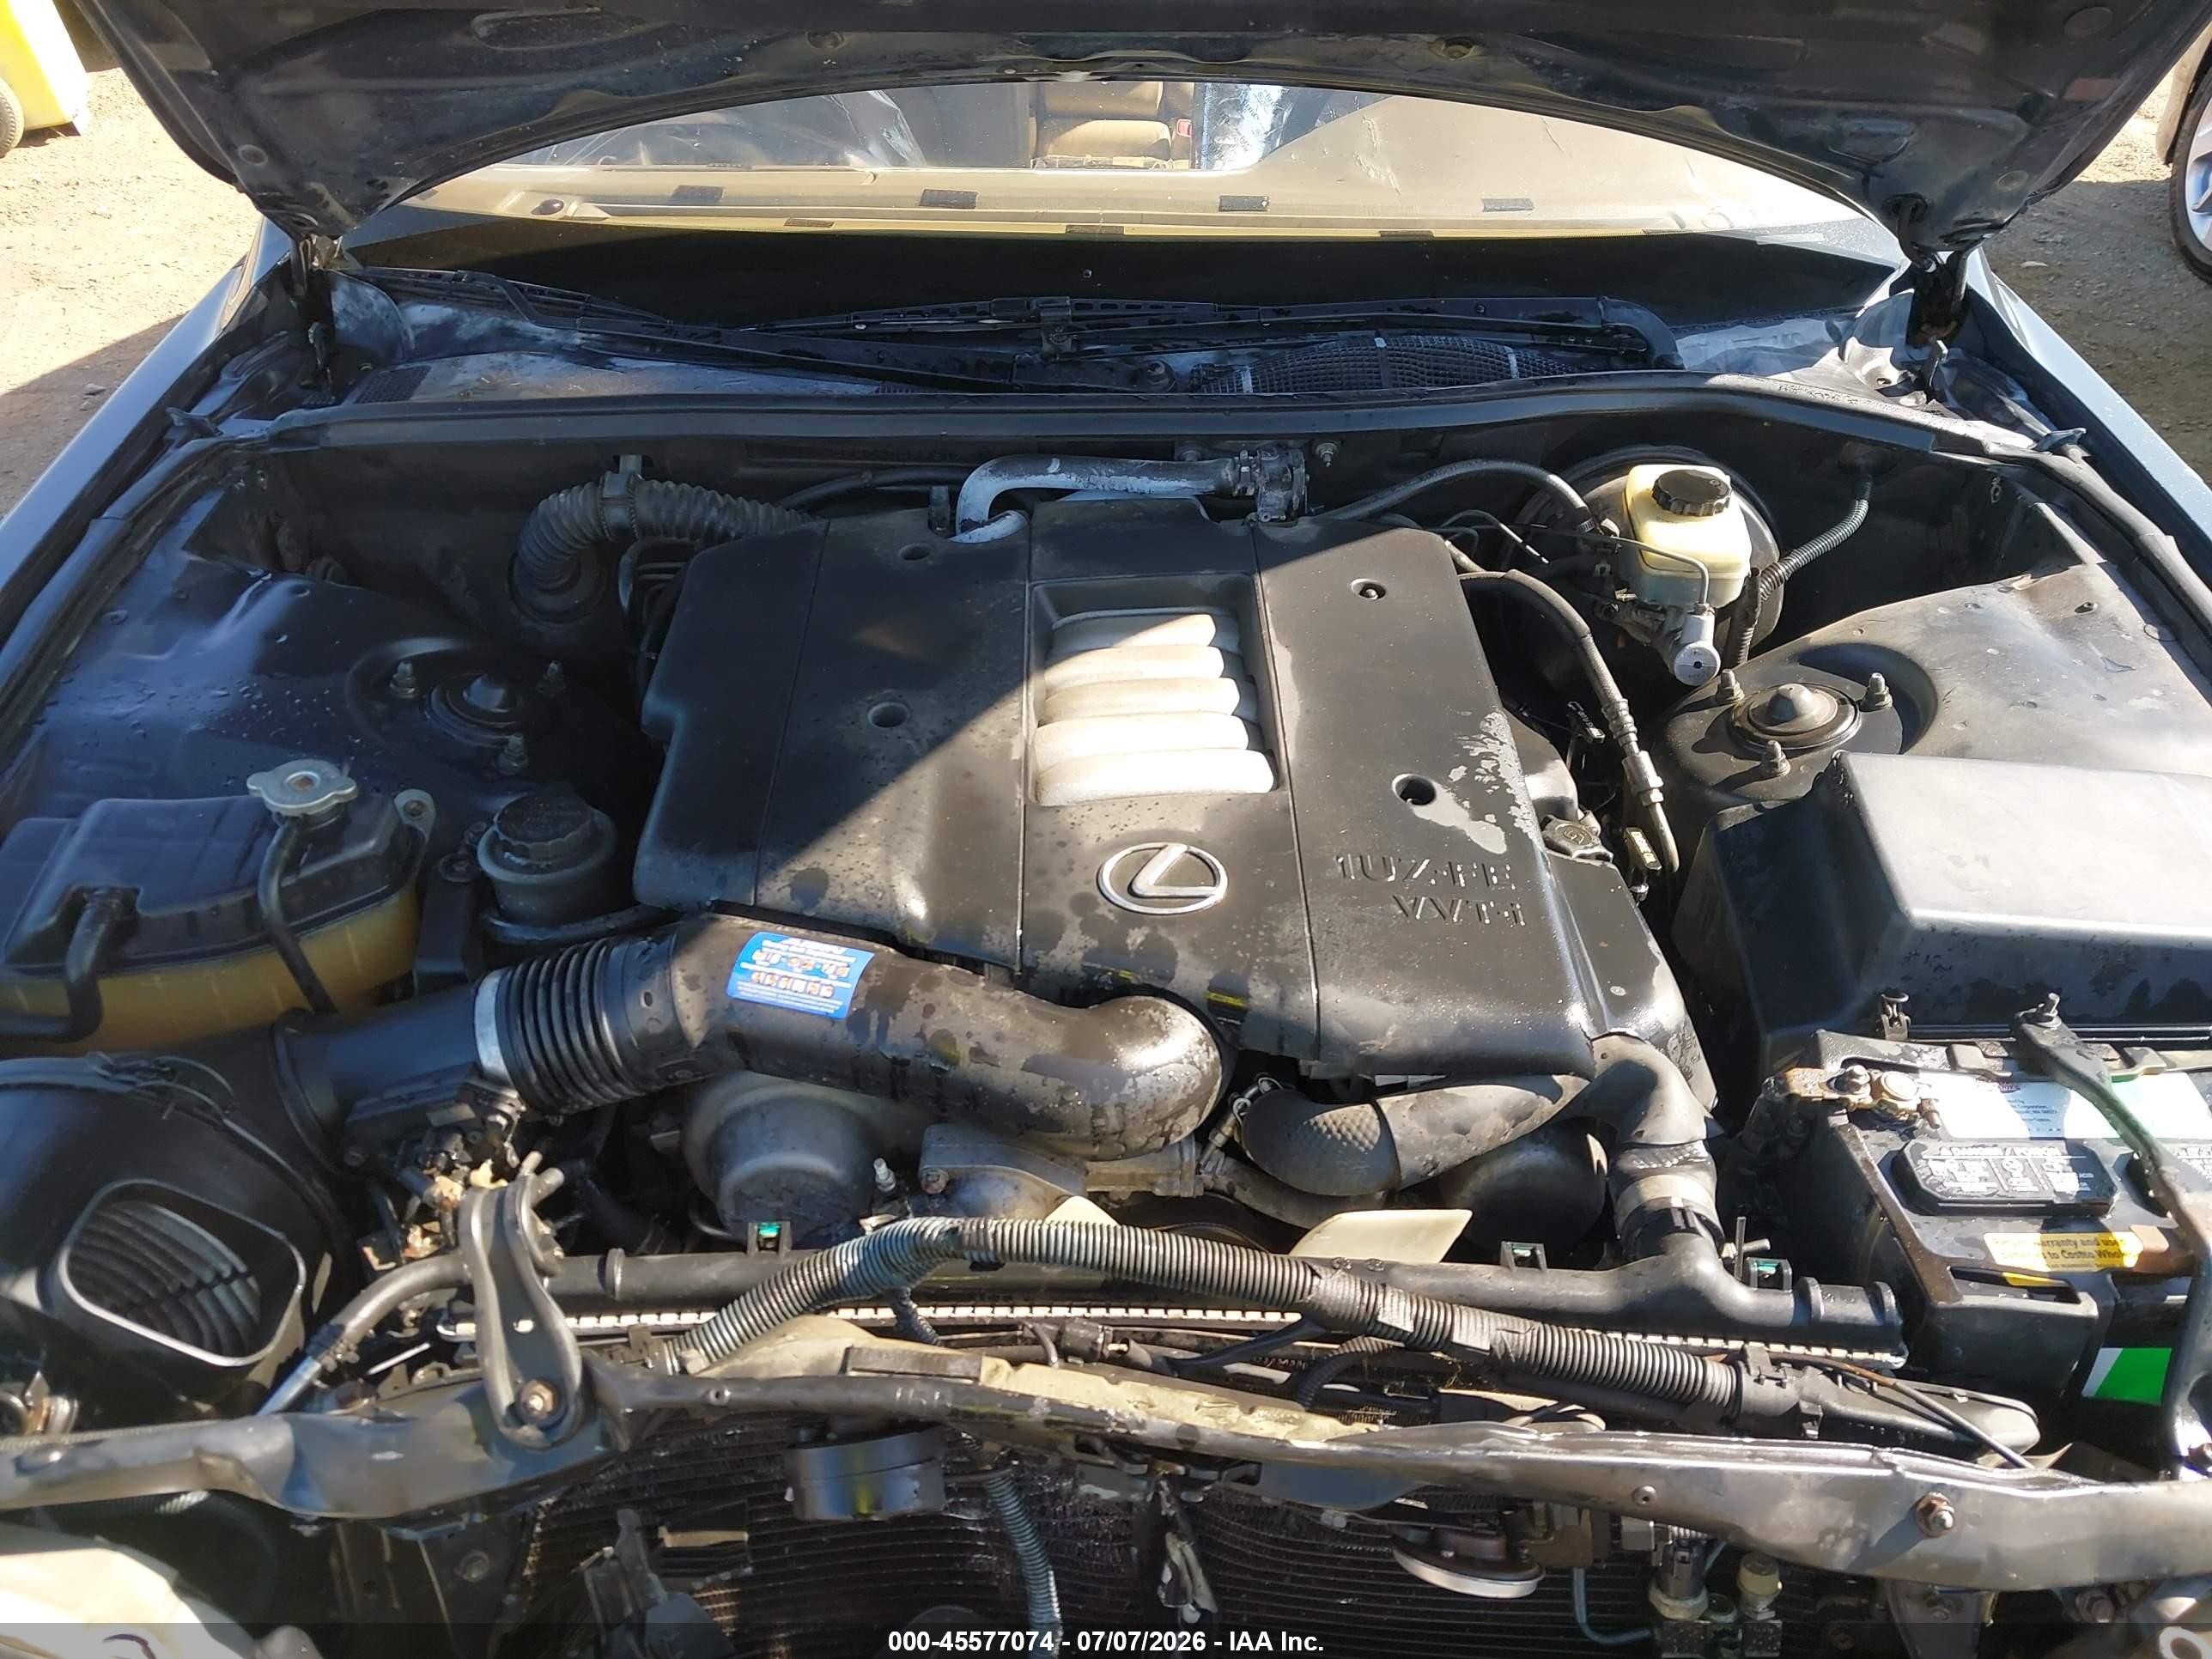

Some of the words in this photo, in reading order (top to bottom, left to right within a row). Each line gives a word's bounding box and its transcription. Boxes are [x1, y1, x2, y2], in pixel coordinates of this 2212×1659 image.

[2080, 1237, 2100, 1247] and
[2101, 1238, 2127, 1247] use
[2061, 1250, 2095, 1259] Costco
